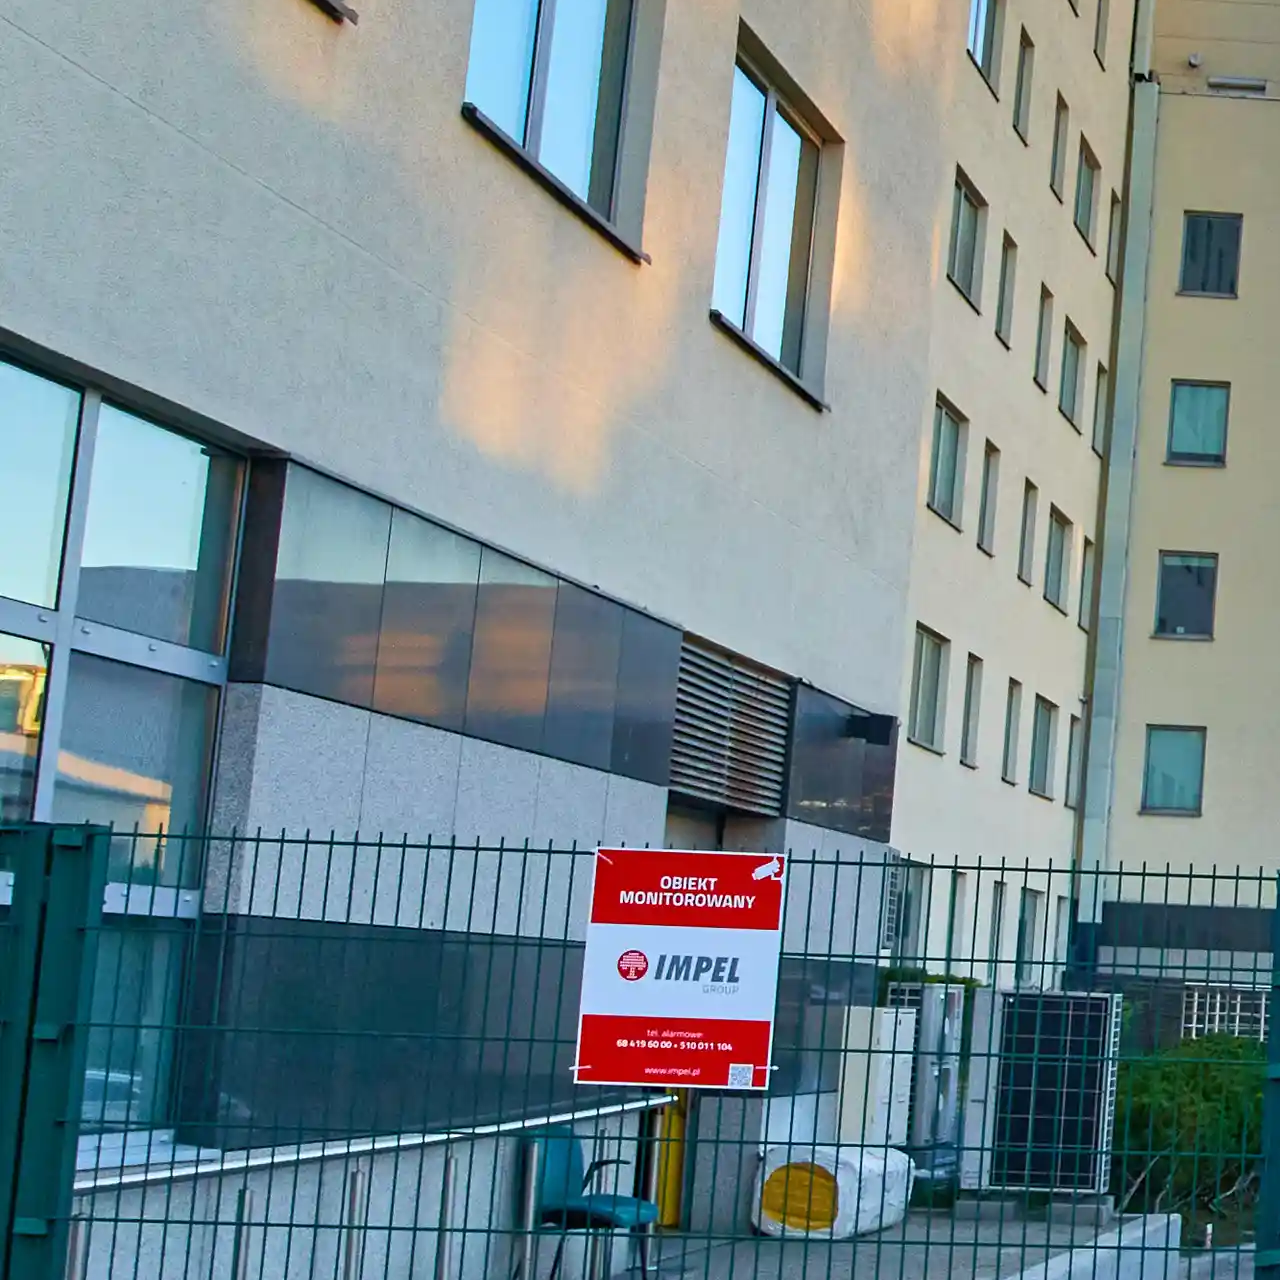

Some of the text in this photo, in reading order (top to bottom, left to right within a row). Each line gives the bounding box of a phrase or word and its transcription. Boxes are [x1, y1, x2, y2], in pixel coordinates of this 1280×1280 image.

[660, 875, 718, 891] OBIEKT
[619, 890, 756, 909] MONITOROWANY
[654, 954, 740, 983] IMPEL
[702, 984, 740, 995] GROUP
[616, 1039, 628, 1048] 68
[629, 1039, 646, 1048] 419
[680, 1041, 696, 1050] 510
[697, 1042, 714, 1051] 011
[717, 1042, 733, 1051] 104
